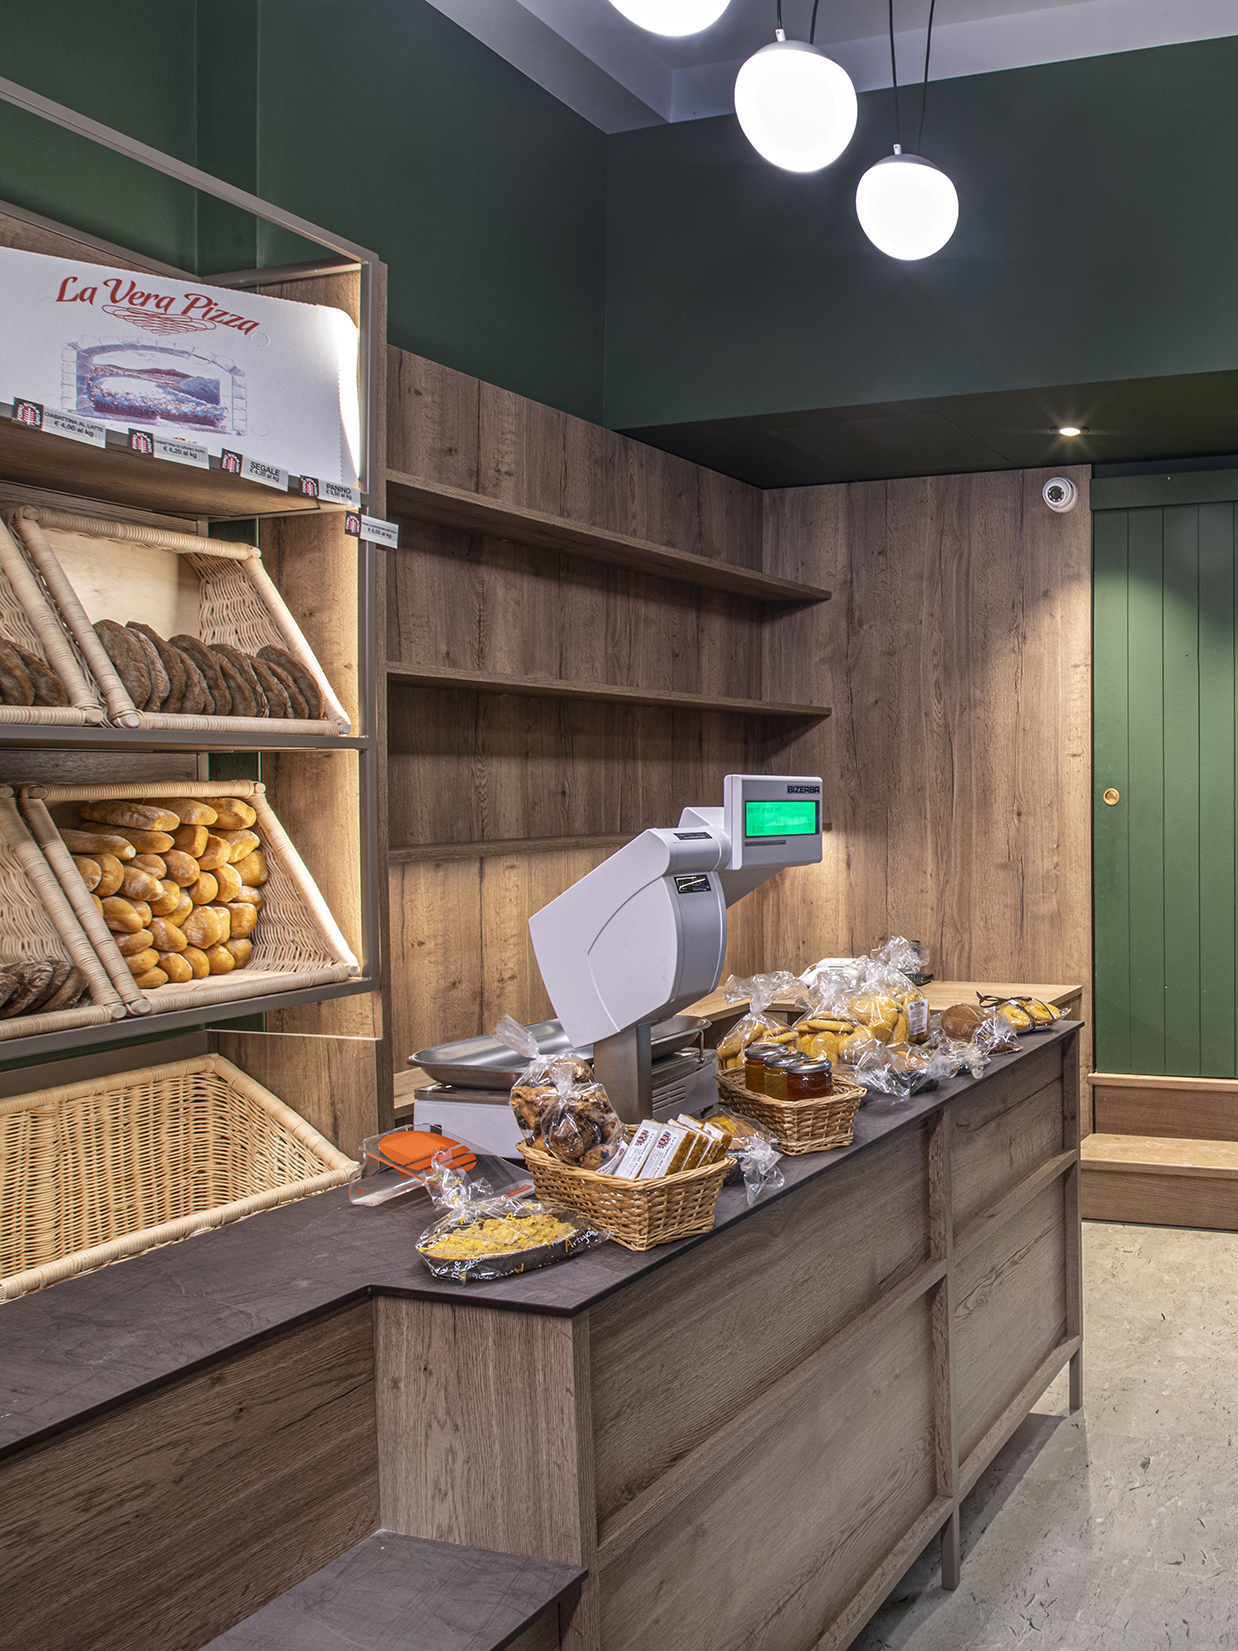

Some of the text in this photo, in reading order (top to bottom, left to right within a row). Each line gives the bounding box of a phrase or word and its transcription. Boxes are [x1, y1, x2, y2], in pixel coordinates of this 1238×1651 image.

[56, 276, 260, 336] La Vera Pizza
[44, 411, 78, 424] CIABATTINA
[86, 423, 104, 432] LATTE
[250, 462, 280, 476] SEGALE
[326, 483, 351, 494] PANINO
[787, 785, 820, 794] BIZERBA
